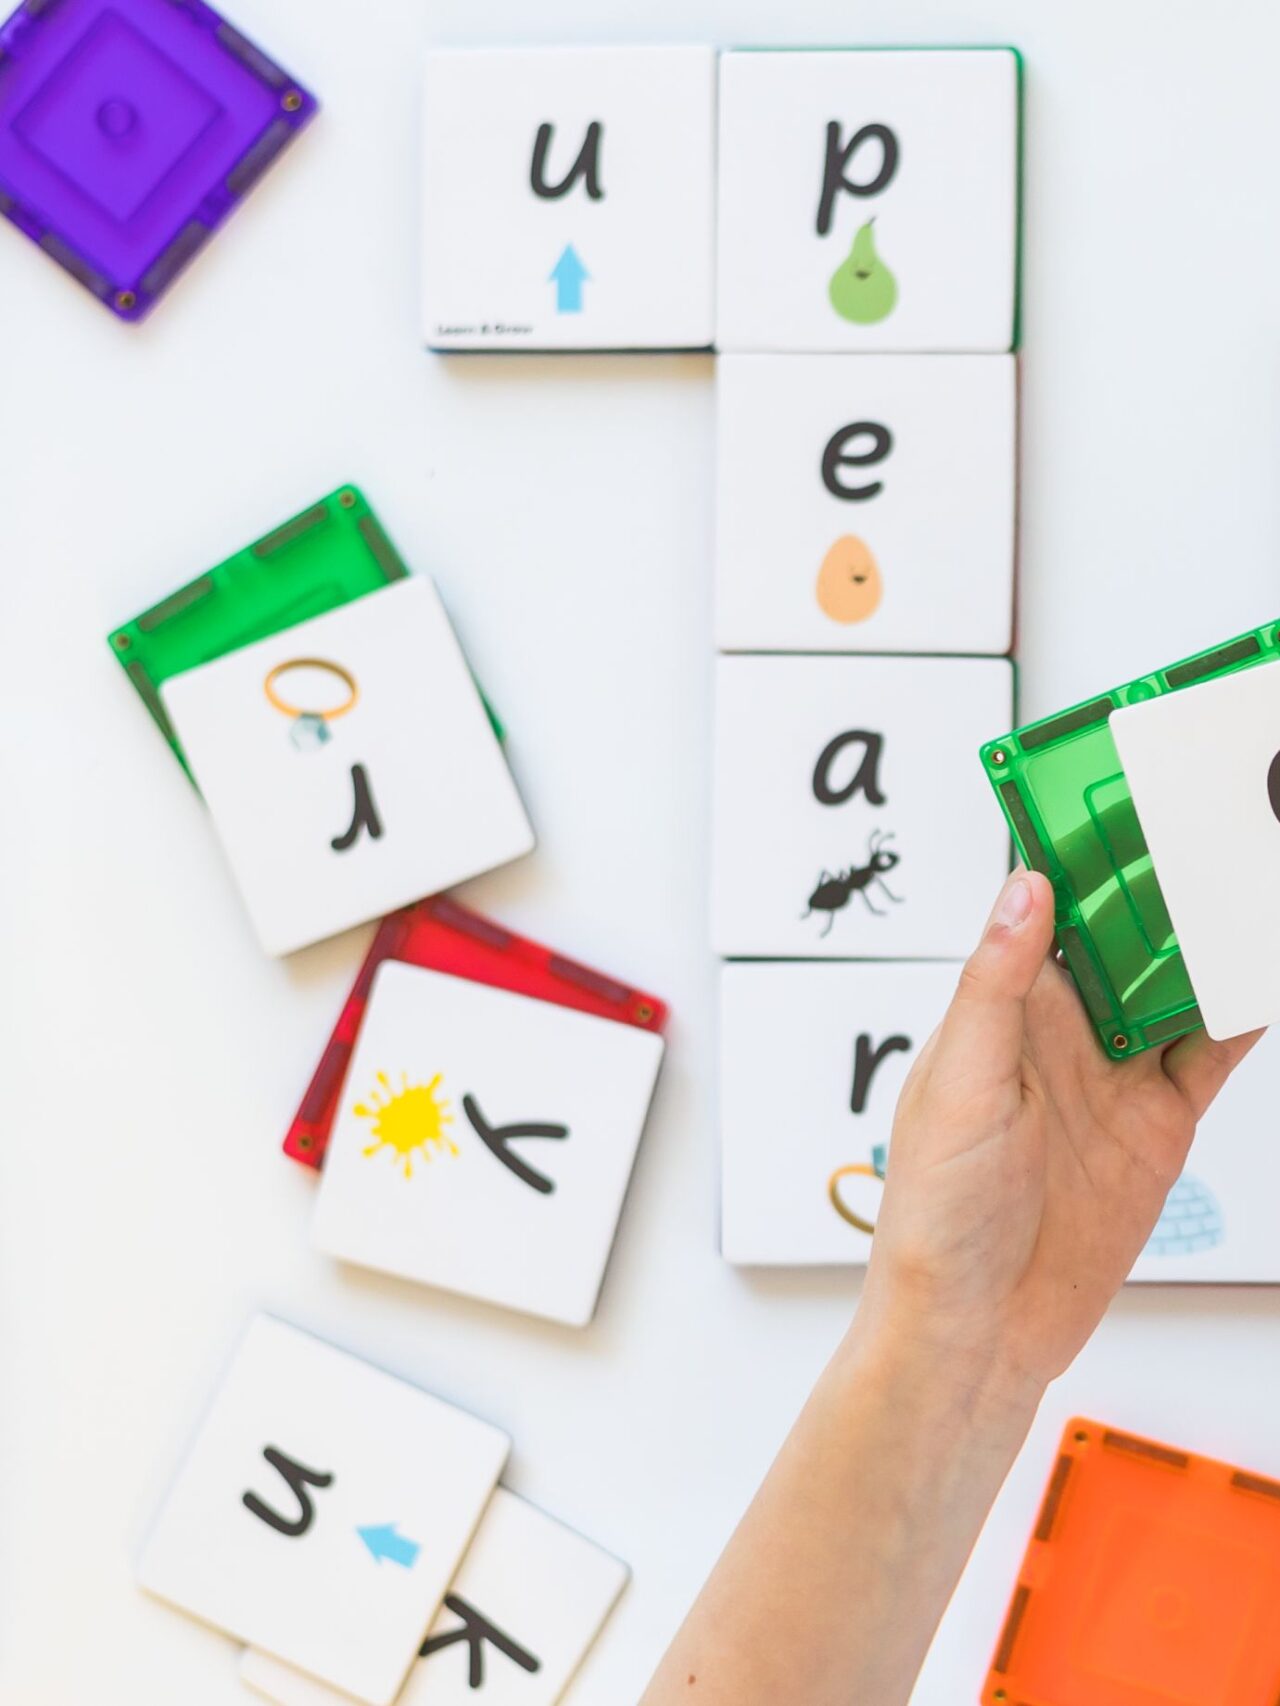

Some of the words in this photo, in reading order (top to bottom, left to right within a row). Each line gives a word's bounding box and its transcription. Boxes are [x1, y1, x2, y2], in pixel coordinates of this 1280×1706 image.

[529, 120, 604, 200] u
[815, 119, 899, 236] p
[820, 420, 893, 502] e
[811, 729, 886, 807] a
[849, 1032, 911, 1114] r
[419, 1593, 541, 1690] k
